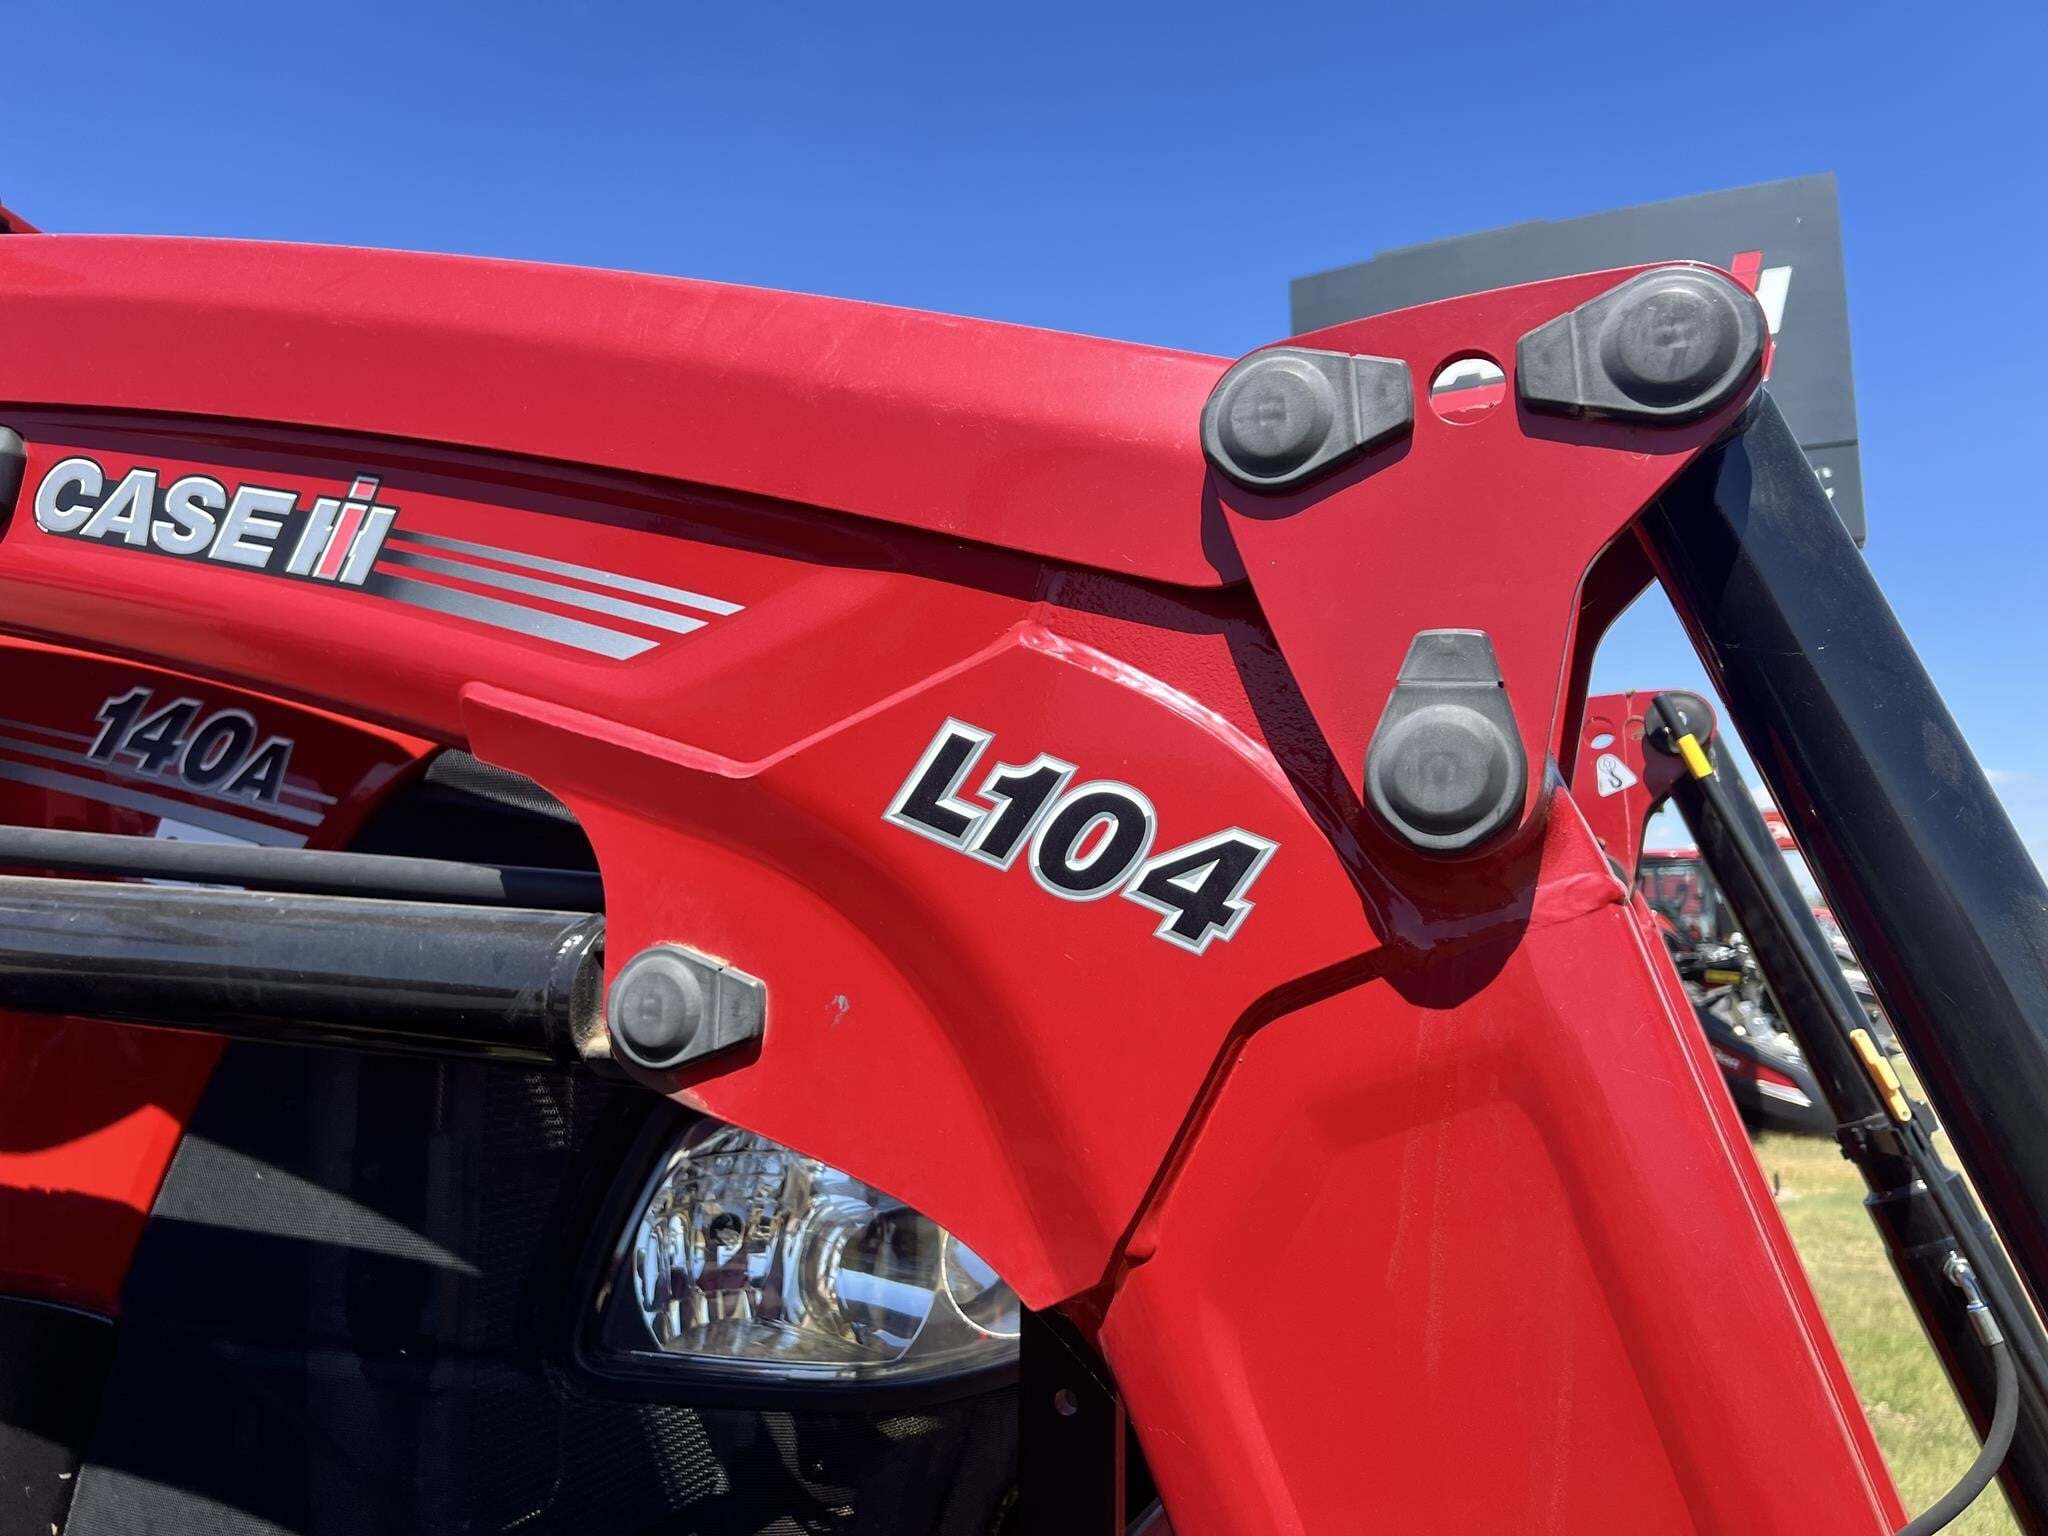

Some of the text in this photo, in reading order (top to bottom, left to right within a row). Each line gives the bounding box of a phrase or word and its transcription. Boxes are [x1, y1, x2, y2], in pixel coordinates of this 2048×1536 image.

[34, 457, 298, 568] CASE
[87, 685, 295, 804] 140A
[881, 715, 1282, 956] L104
